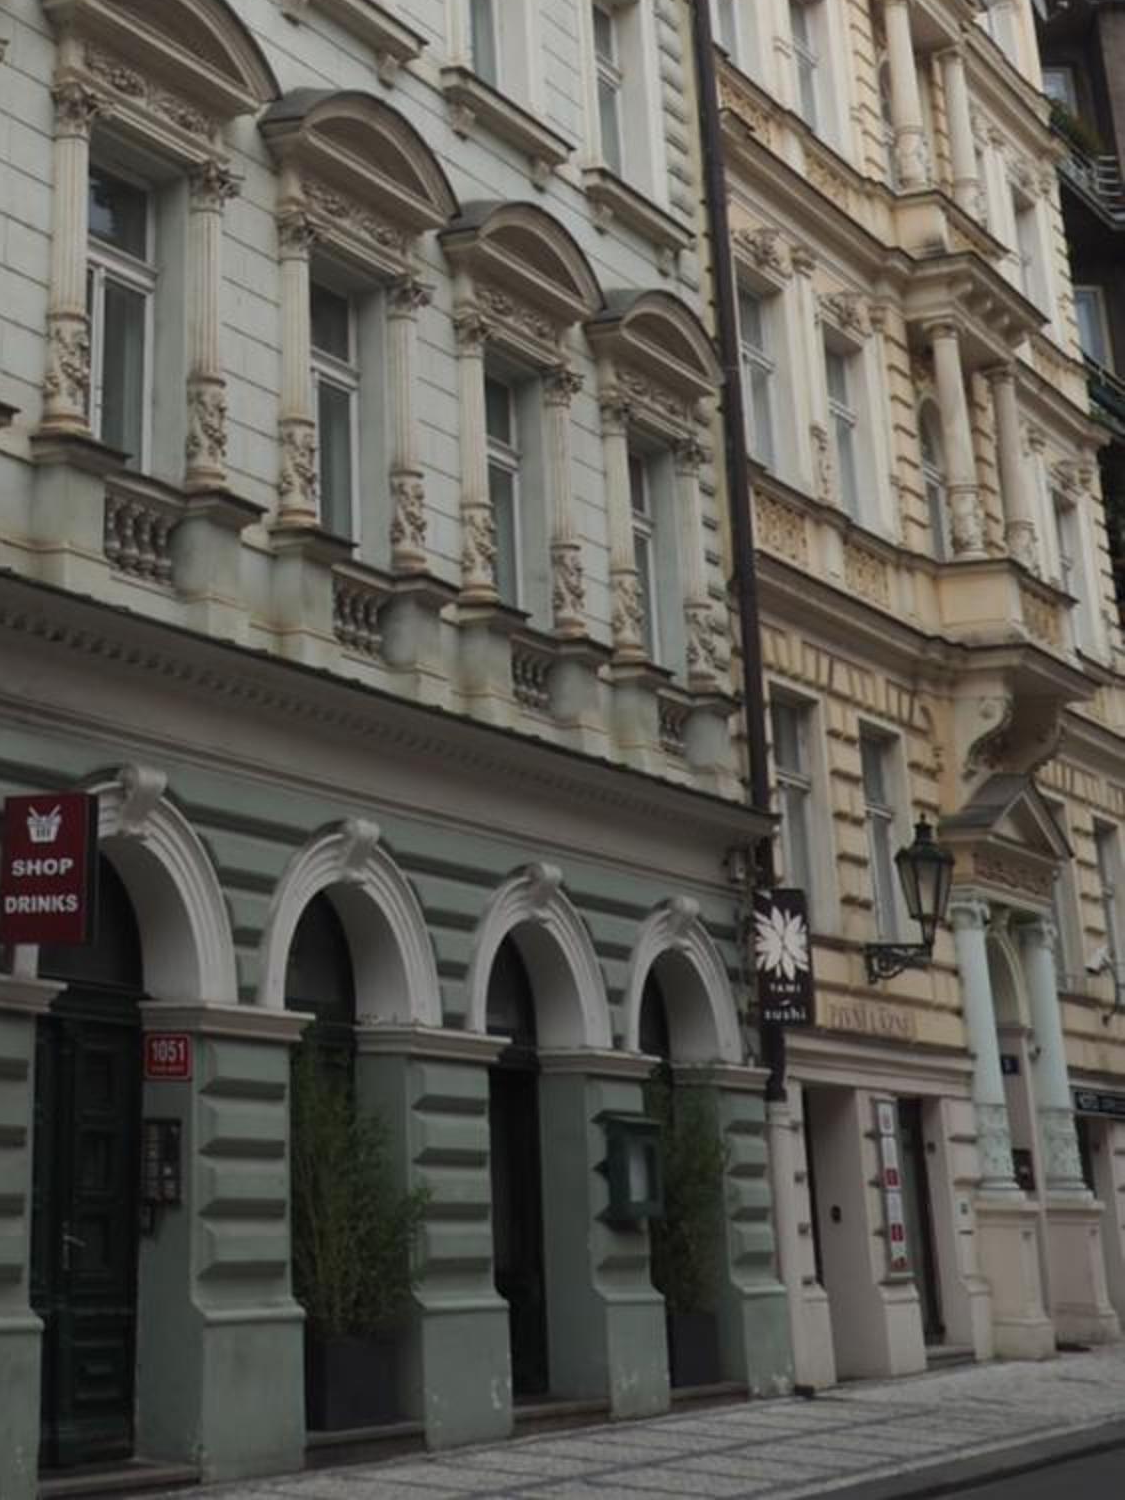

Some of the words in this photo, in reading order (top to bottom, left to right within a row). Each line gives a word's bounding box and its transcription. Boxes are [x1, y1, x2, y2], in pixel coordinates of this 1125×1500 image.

[11, 857, 74, 877] SHOP
[4, 894, 78, 914] DRINKS
[764, 1005, 806, 1021] sushi
[152, 1040, 185, 1062] 1051
